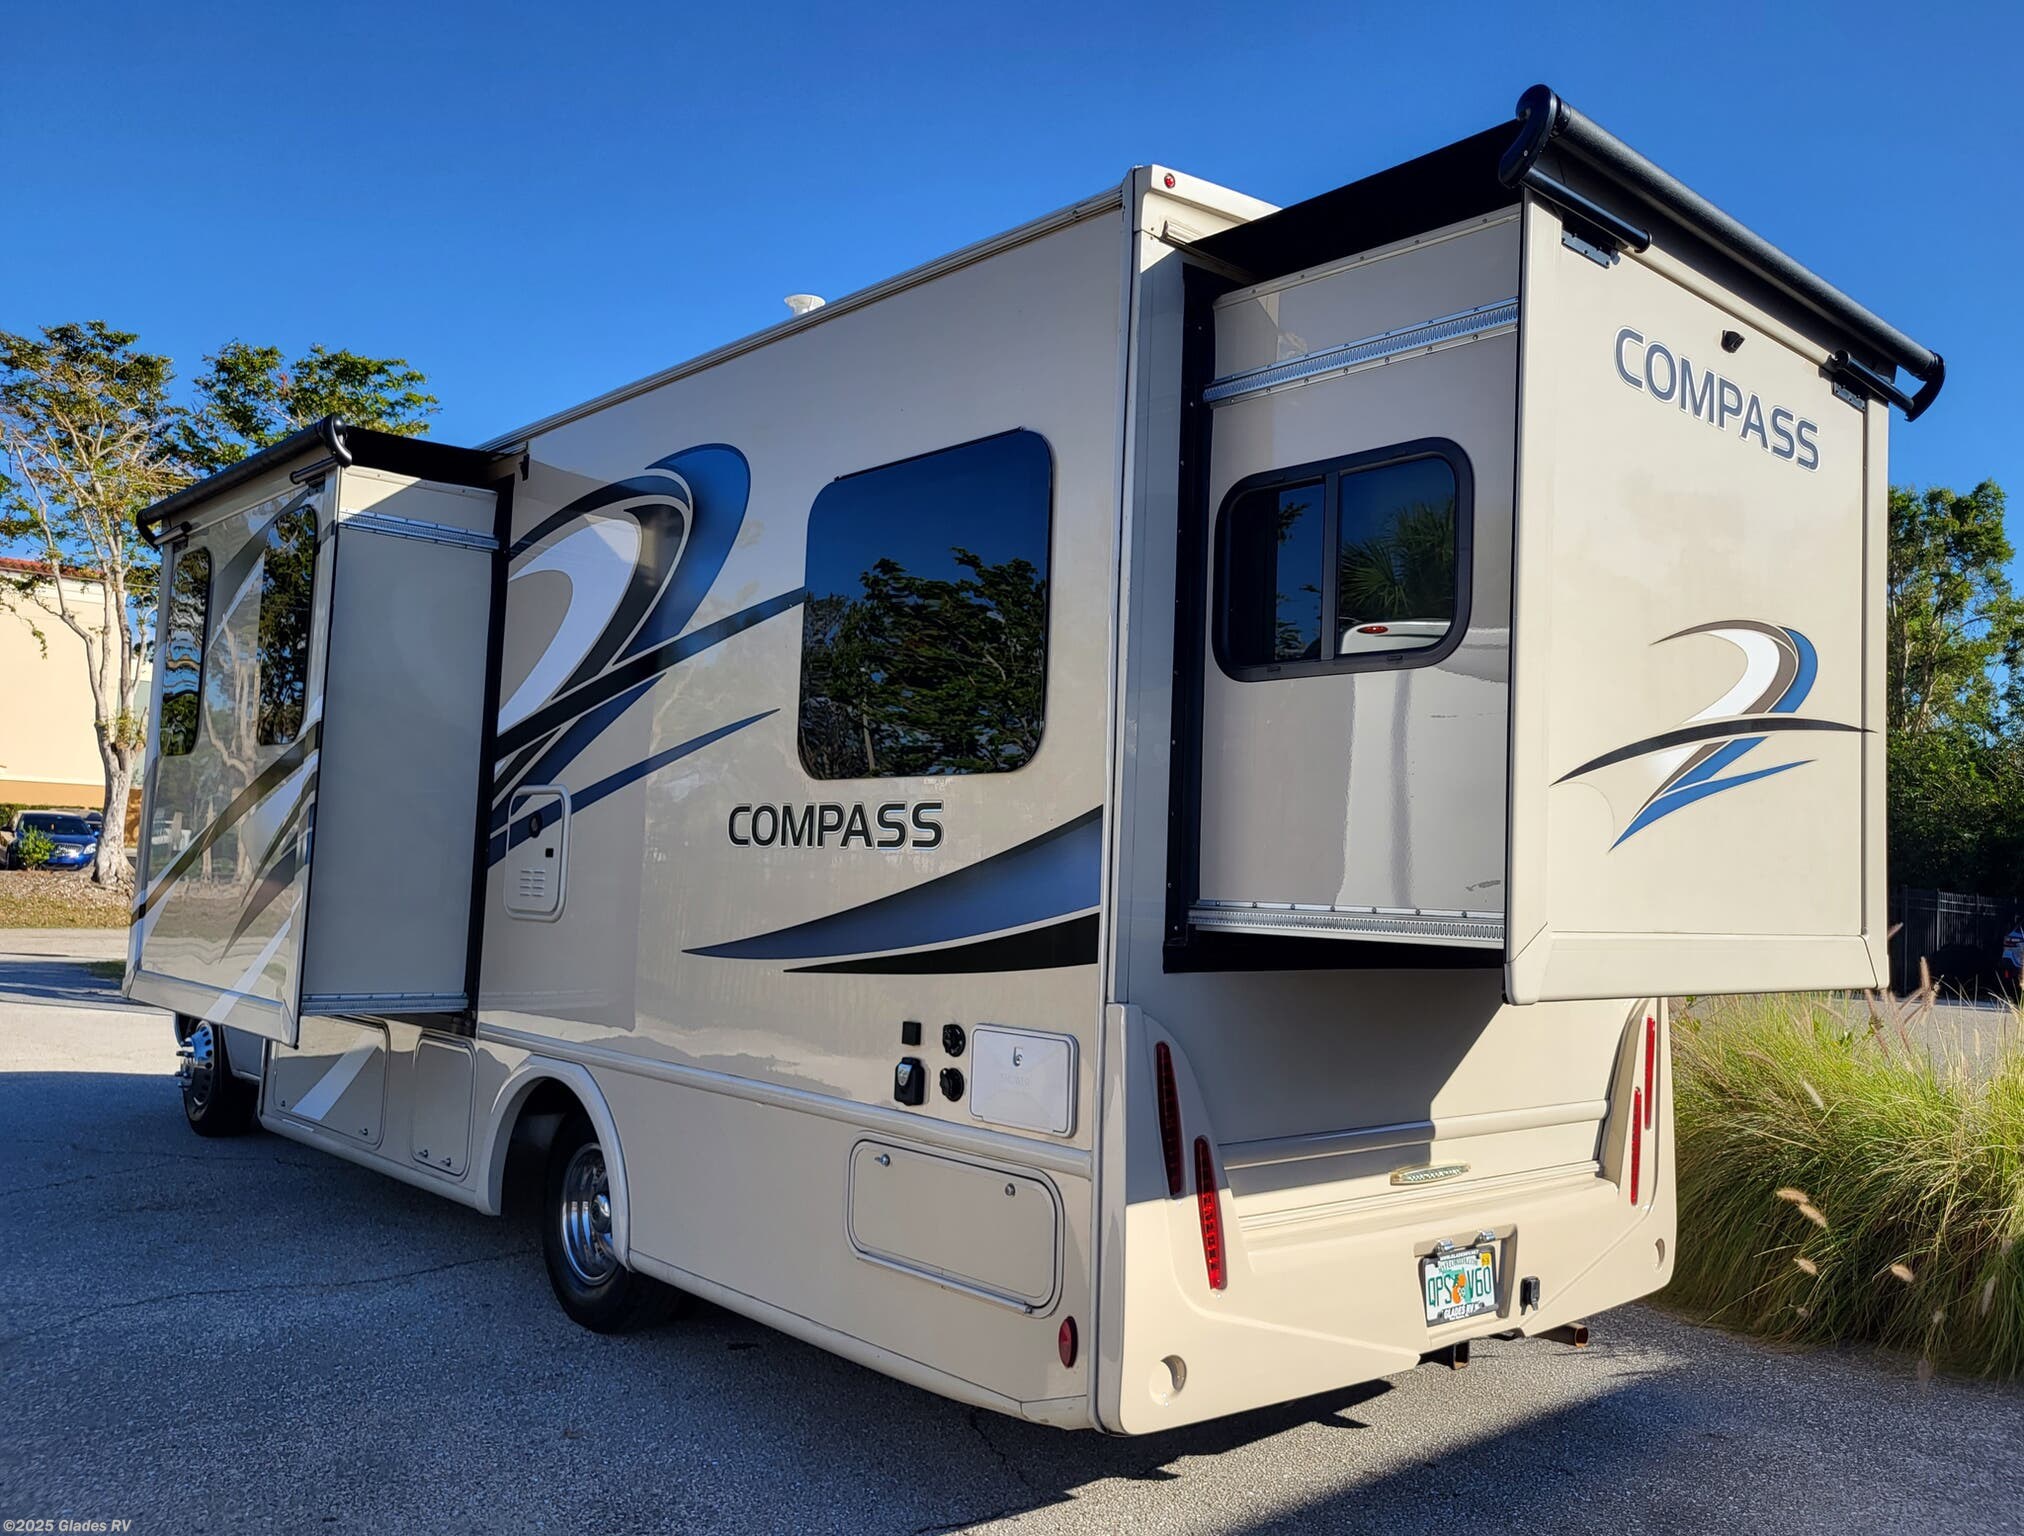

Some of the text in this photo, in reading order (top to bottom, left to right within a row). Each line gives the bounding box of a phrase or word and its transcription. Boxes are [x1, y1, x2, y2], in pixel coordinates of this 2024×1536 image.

[1615, 326, 1820, 471] COMPASS
[728, 801, 943, 849] COMPASS
[1427, 1273, 1452, 1308] QPS
